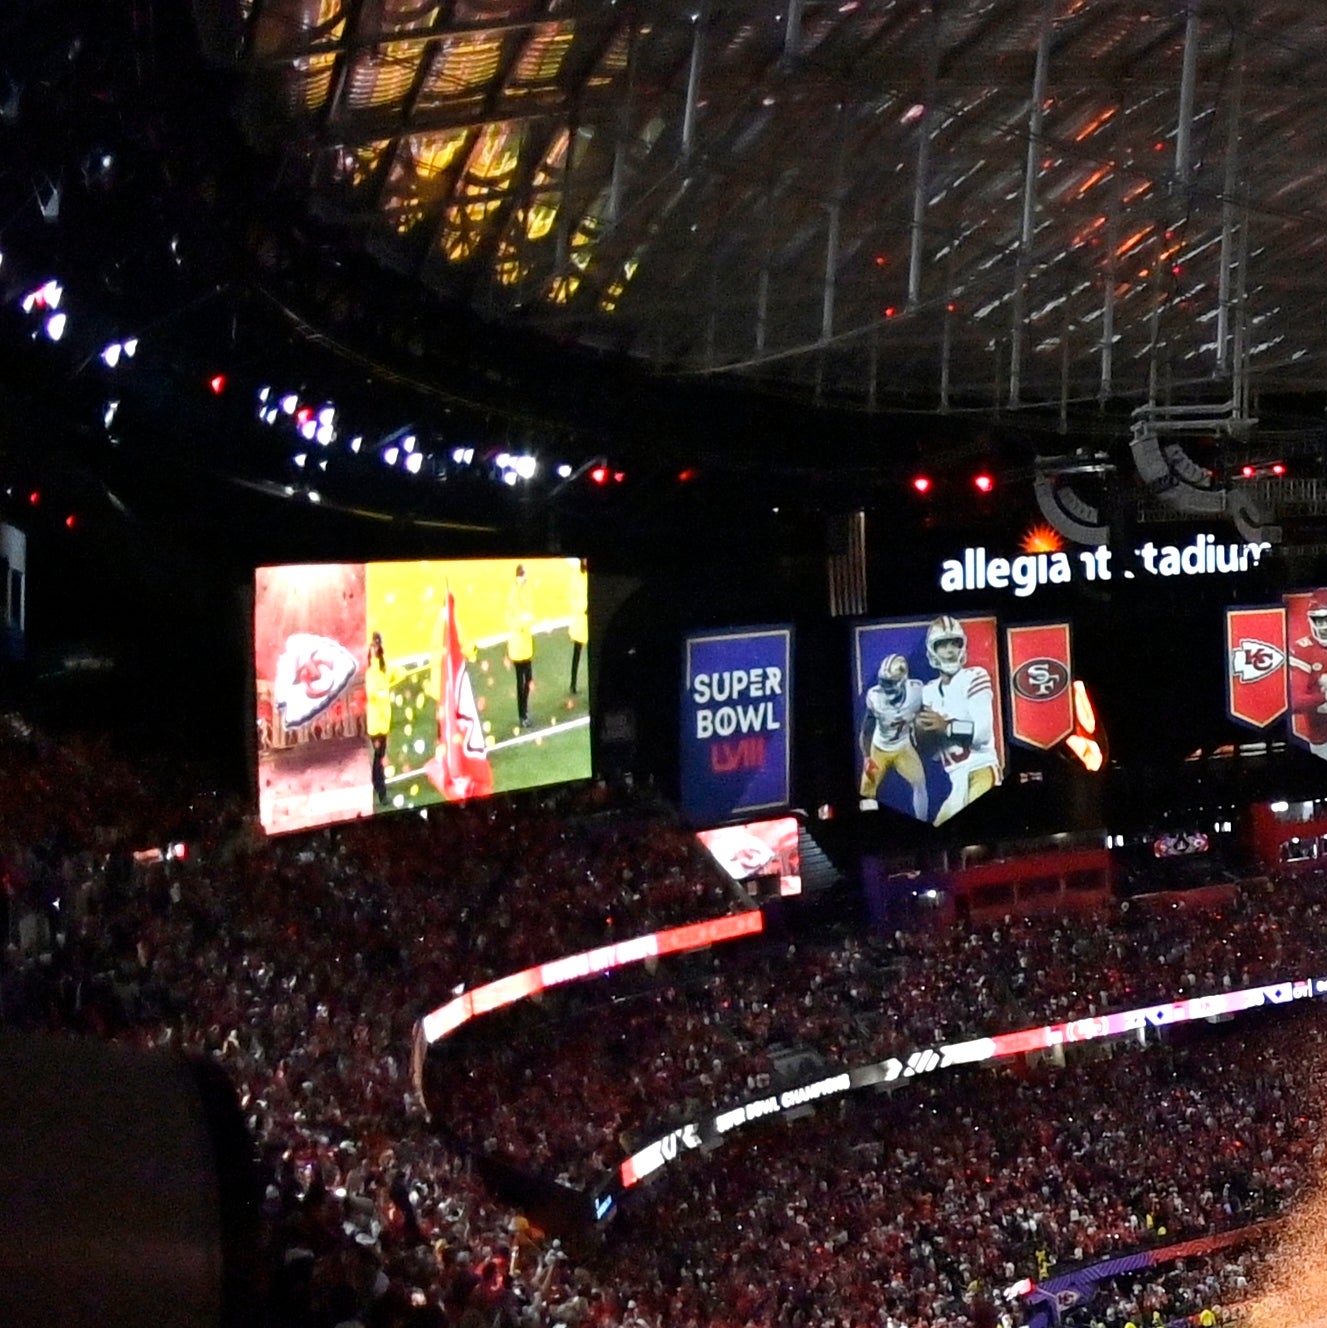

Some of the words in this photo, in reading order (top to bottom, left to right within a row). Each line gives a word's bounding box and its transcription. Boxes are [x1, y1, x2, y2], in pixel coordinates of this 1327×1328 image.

[1125, 534, 1272, 580] tadiu
[693, 667, 781, 703] SUPER
[696, 702, 780, 739] BOWL
[711, 739, 764, 773] LVIII
